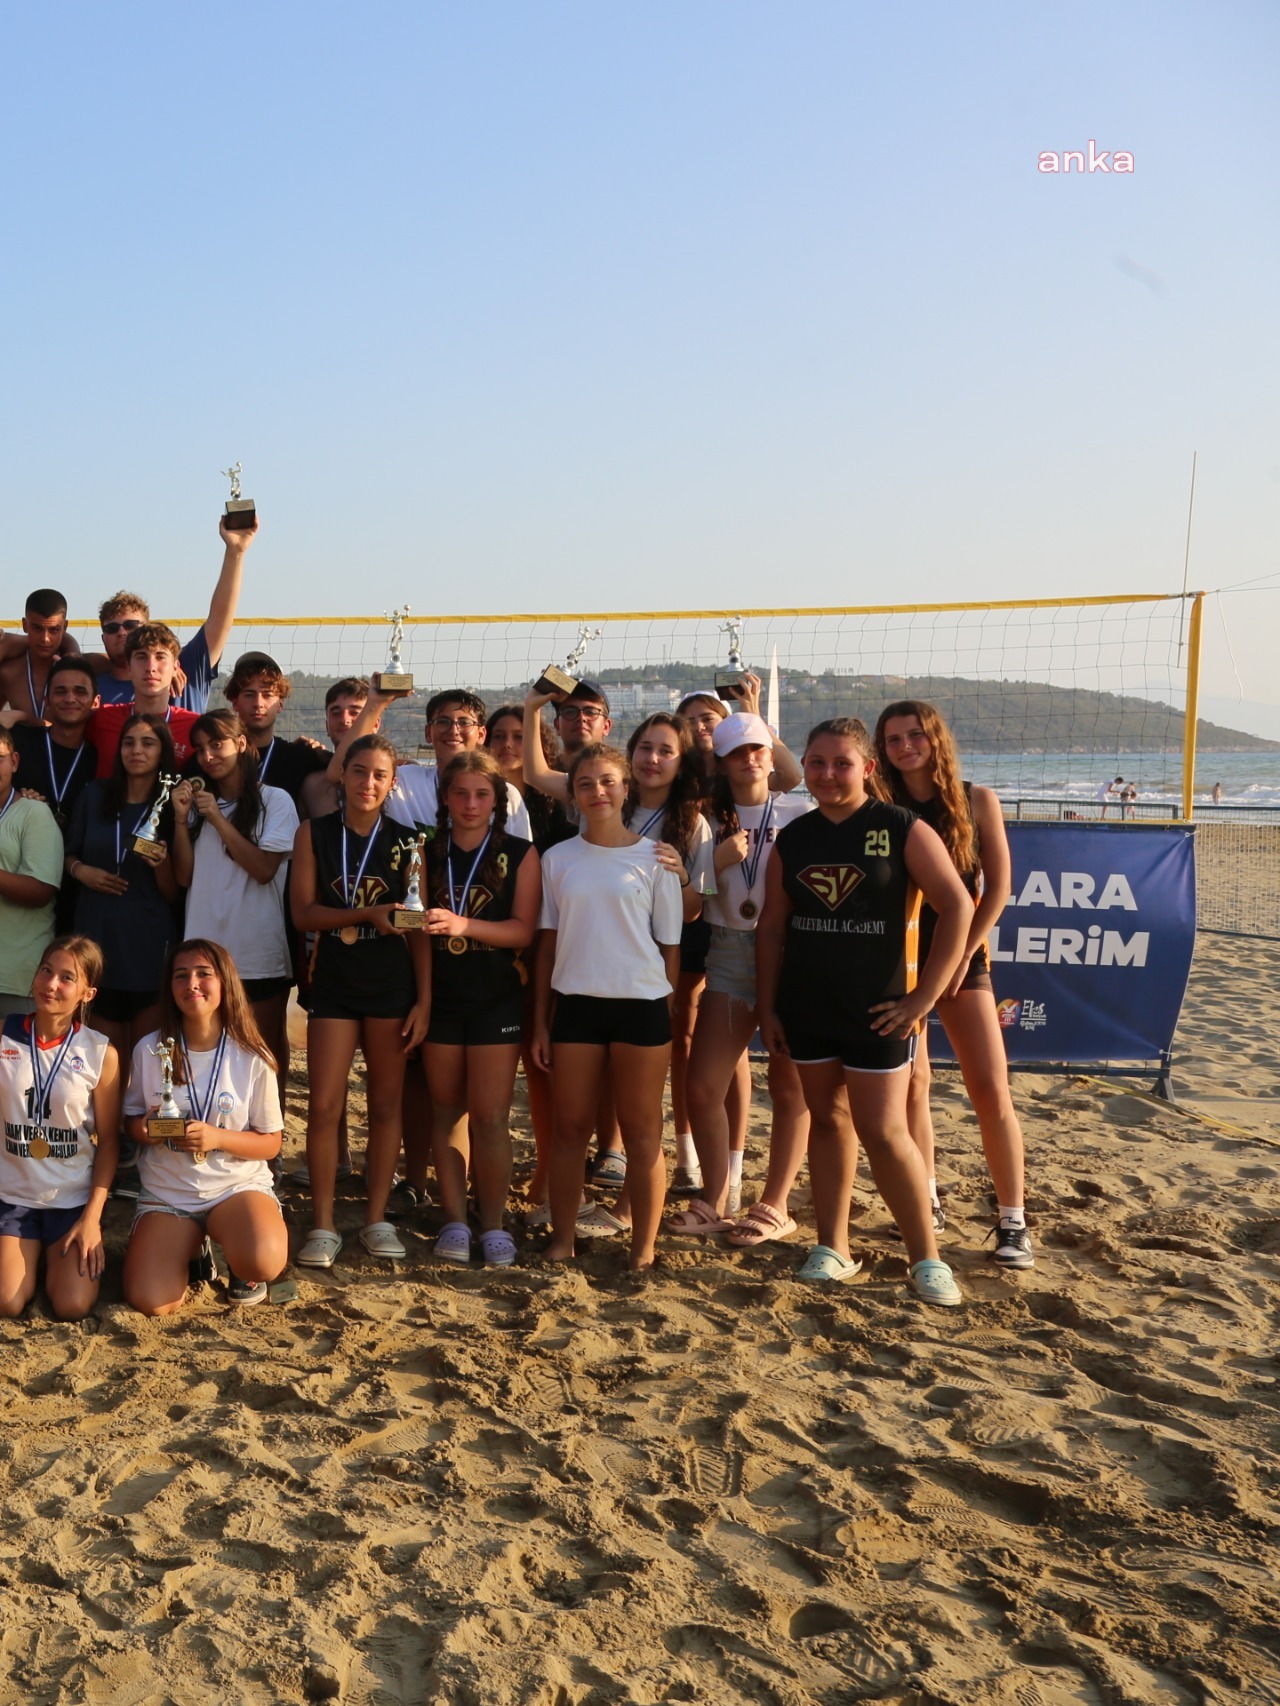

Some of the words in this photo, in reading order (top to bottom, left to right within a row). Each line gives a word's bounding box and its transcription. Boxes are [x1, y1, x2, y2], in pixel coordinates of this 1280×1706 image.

[865, 829, 890, 858] 29
[390, 845, 401, 871] 3
[792, 915, 839, 933] VOLLEYBALL
[841, 919, 886, 935] ACADEMY
